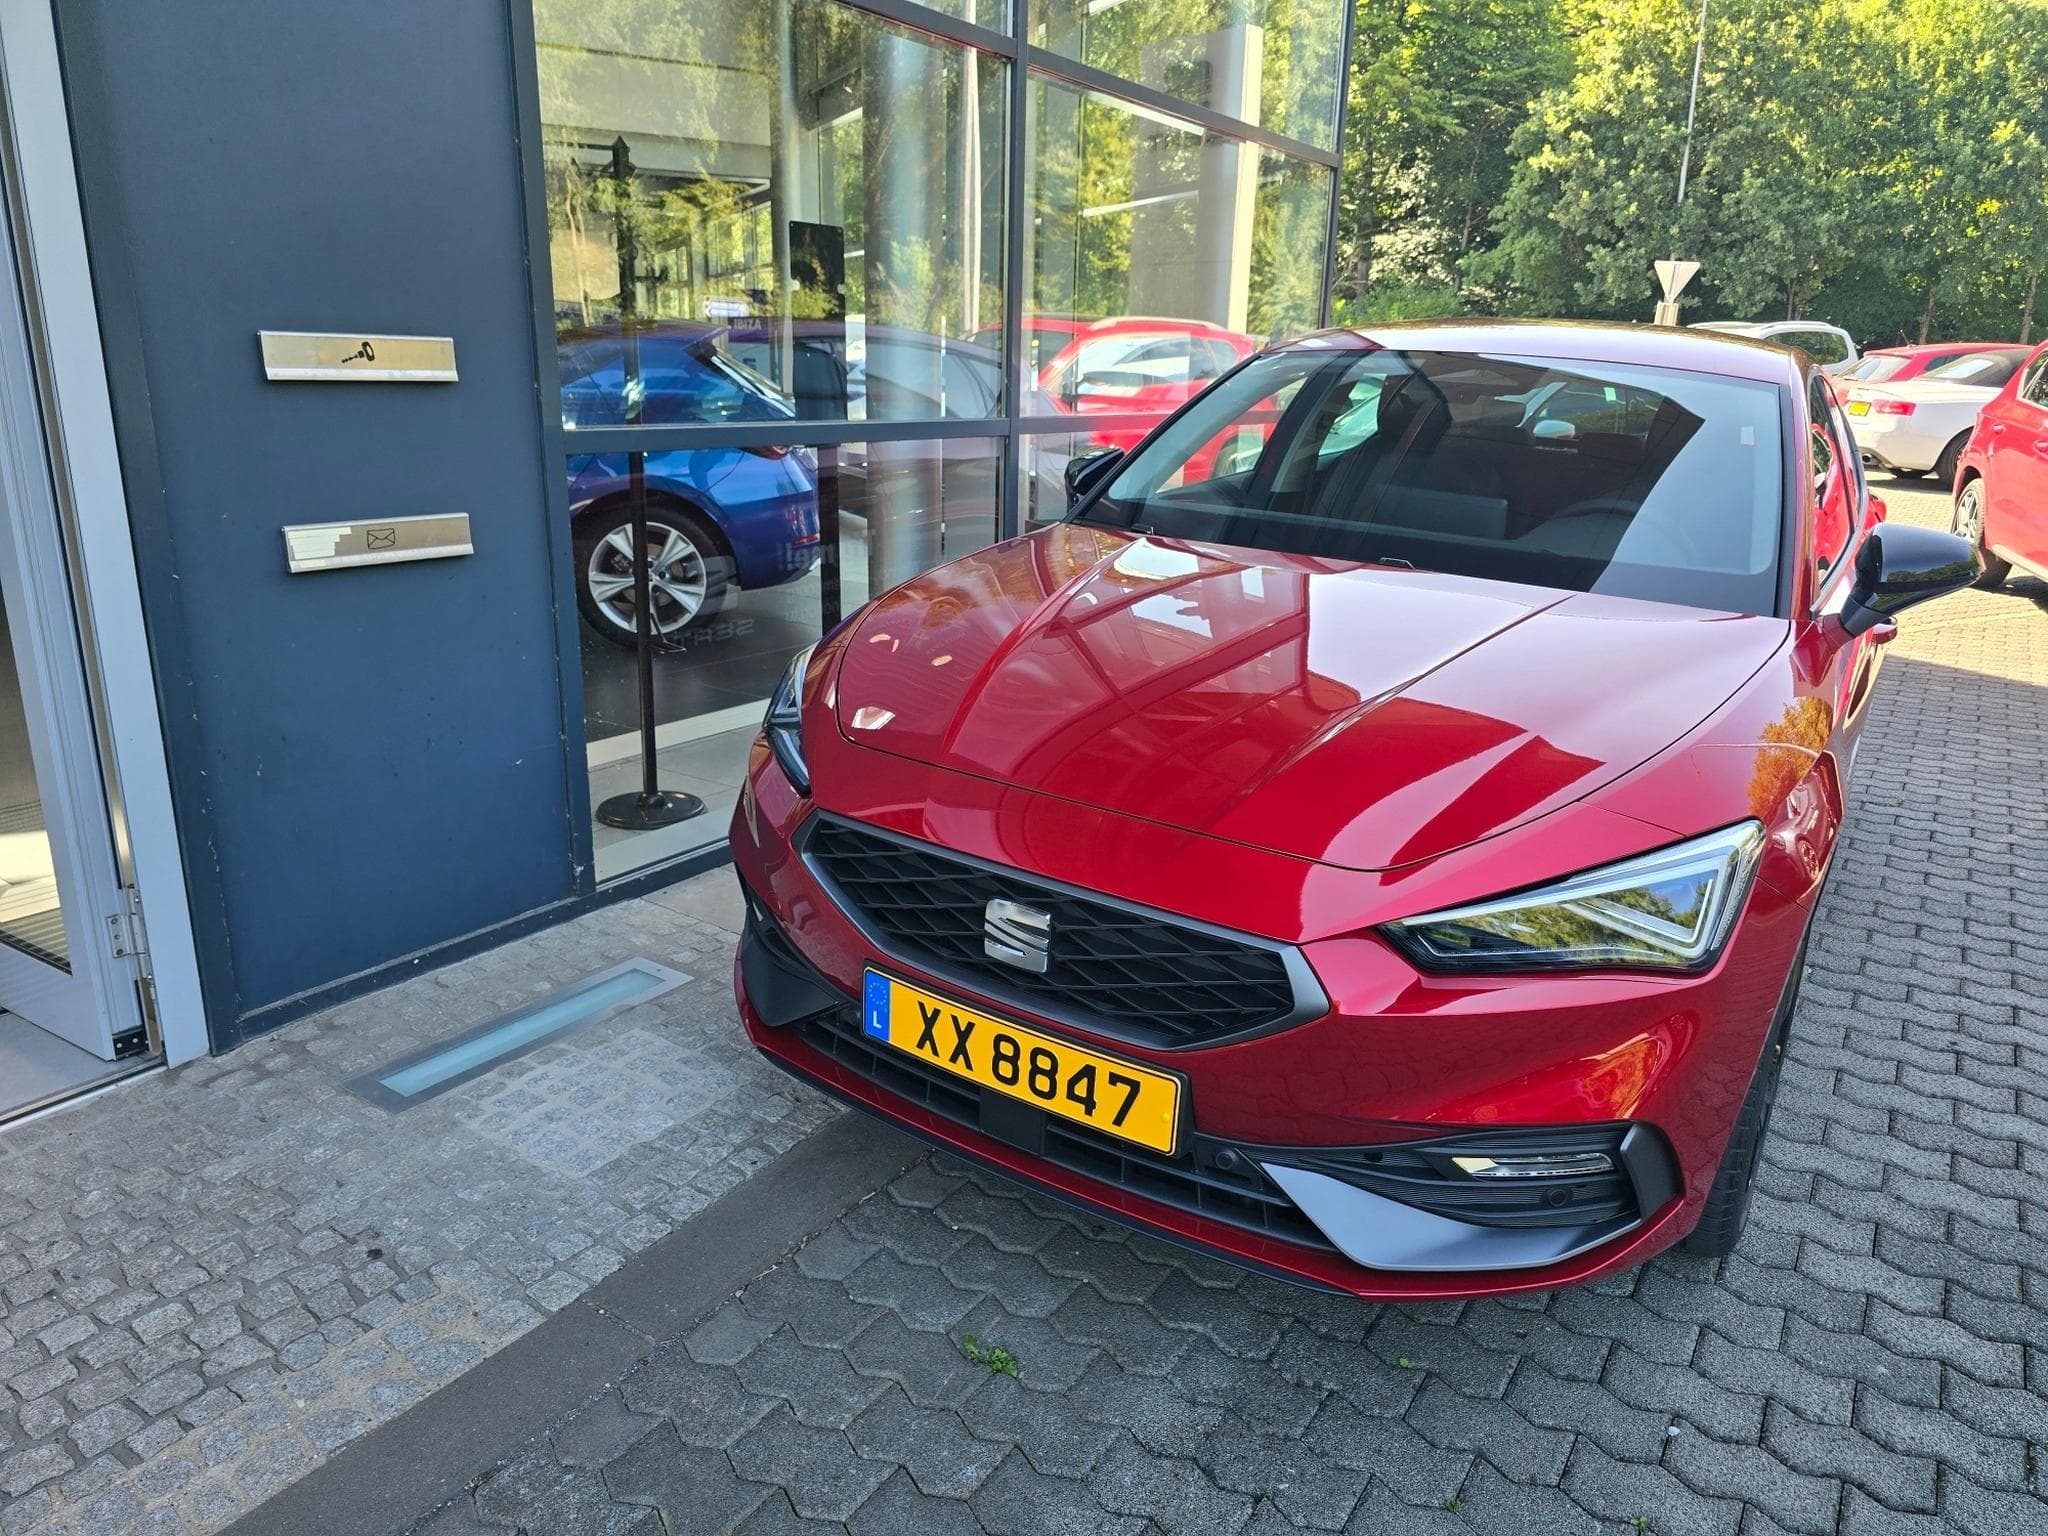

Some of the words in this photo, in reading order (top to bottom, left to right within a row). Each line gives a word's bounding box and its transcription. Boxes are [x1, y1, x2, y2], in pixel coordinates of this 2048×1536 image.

[733, 318, 762, 331] IBIZA
[872, 1010, 883, 1030] L
[916, 1000, 976, 1072] XX
[991, 1033, 1142, 1128] 8847
